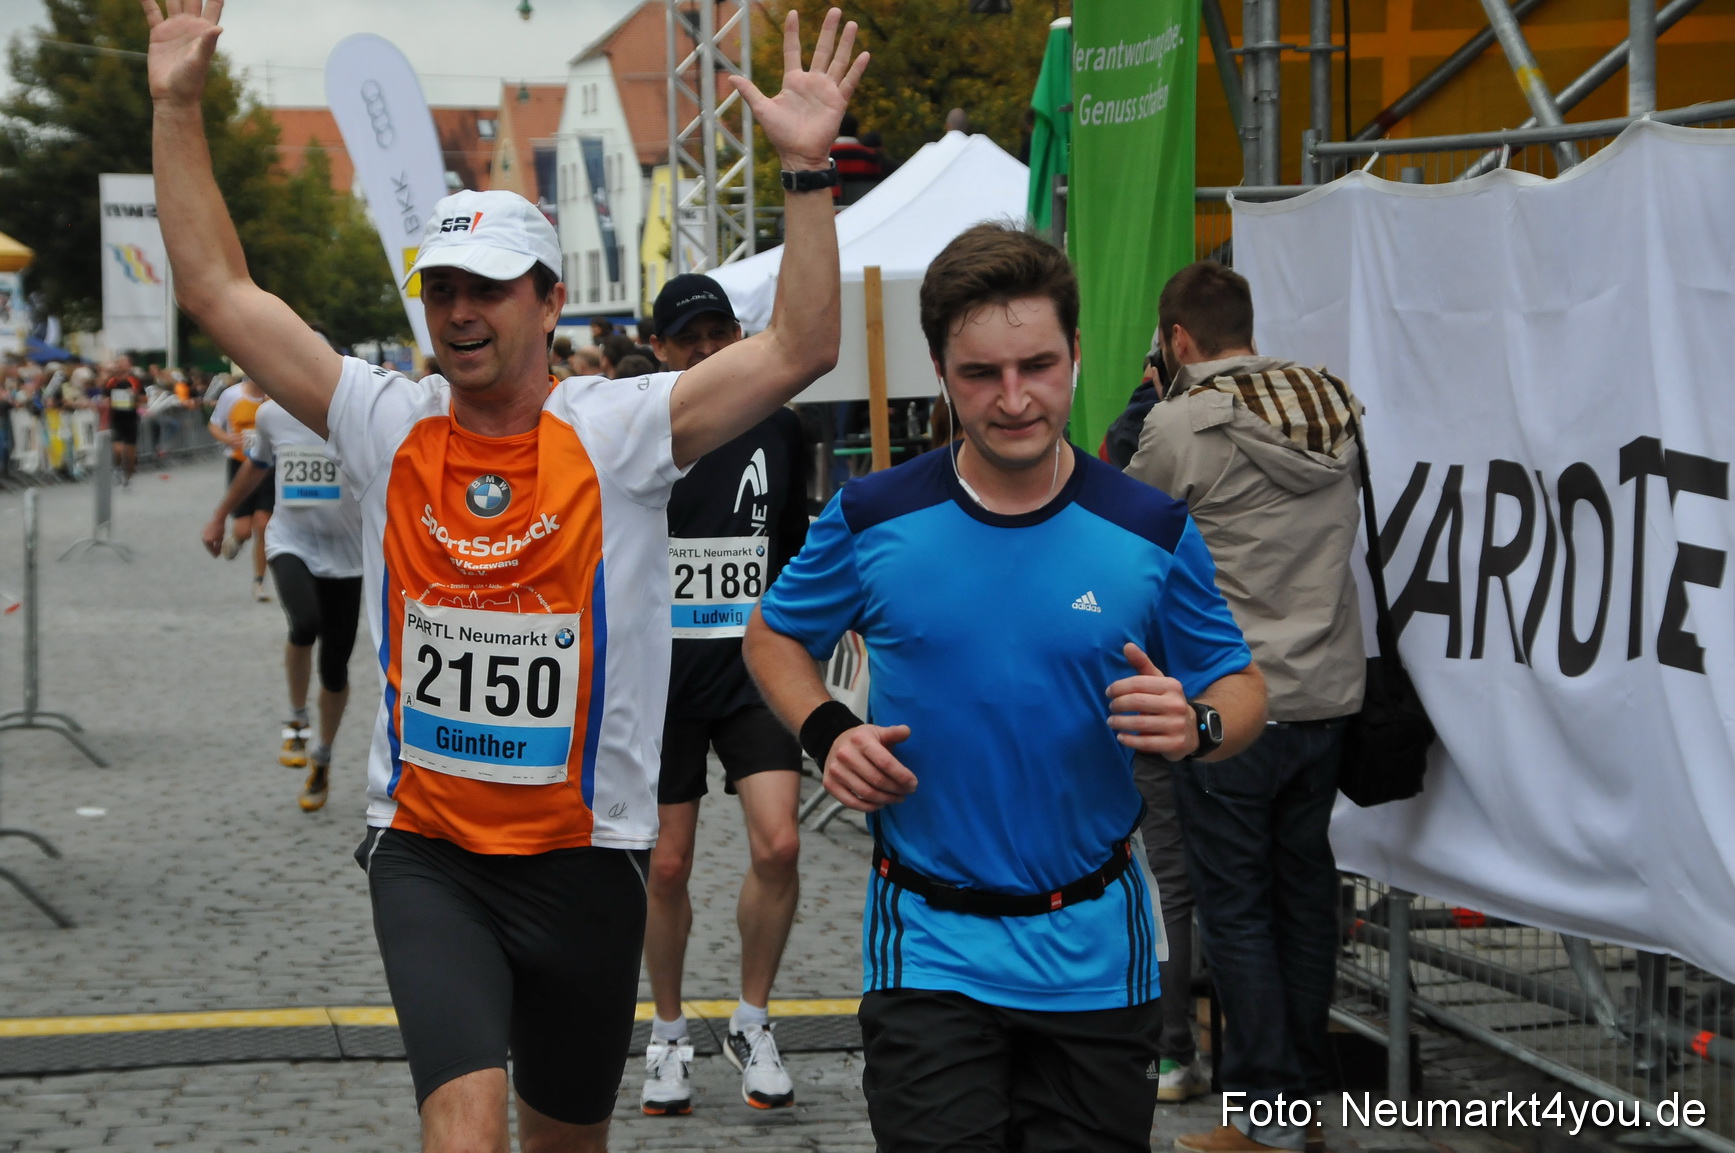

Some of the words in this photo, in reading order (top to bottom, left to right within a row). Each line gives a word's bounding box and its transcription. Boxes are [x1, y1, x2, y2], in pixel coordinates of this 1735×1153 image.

[1079, 93, 1137, 126] Genuss
[390, 170, 419, 235] BKK
[284, 461, 336, 483] 2389
[471, 475, 508, 492] BMW
[669, 547, 701, 558] PARTL
[704, 547, 752, 558] Neumarkt
[674, 562, 761, 599] 2188
[693, 609, 743, 626] Ludwig
[1071, 602, 1102, 613] adidas
[408, 613, 454, 640] PARTL
[459, 626, 547, 647] Neumarkt
[416, 644, 561, 719] 2150
[436, 725, 527, 760] Günther
